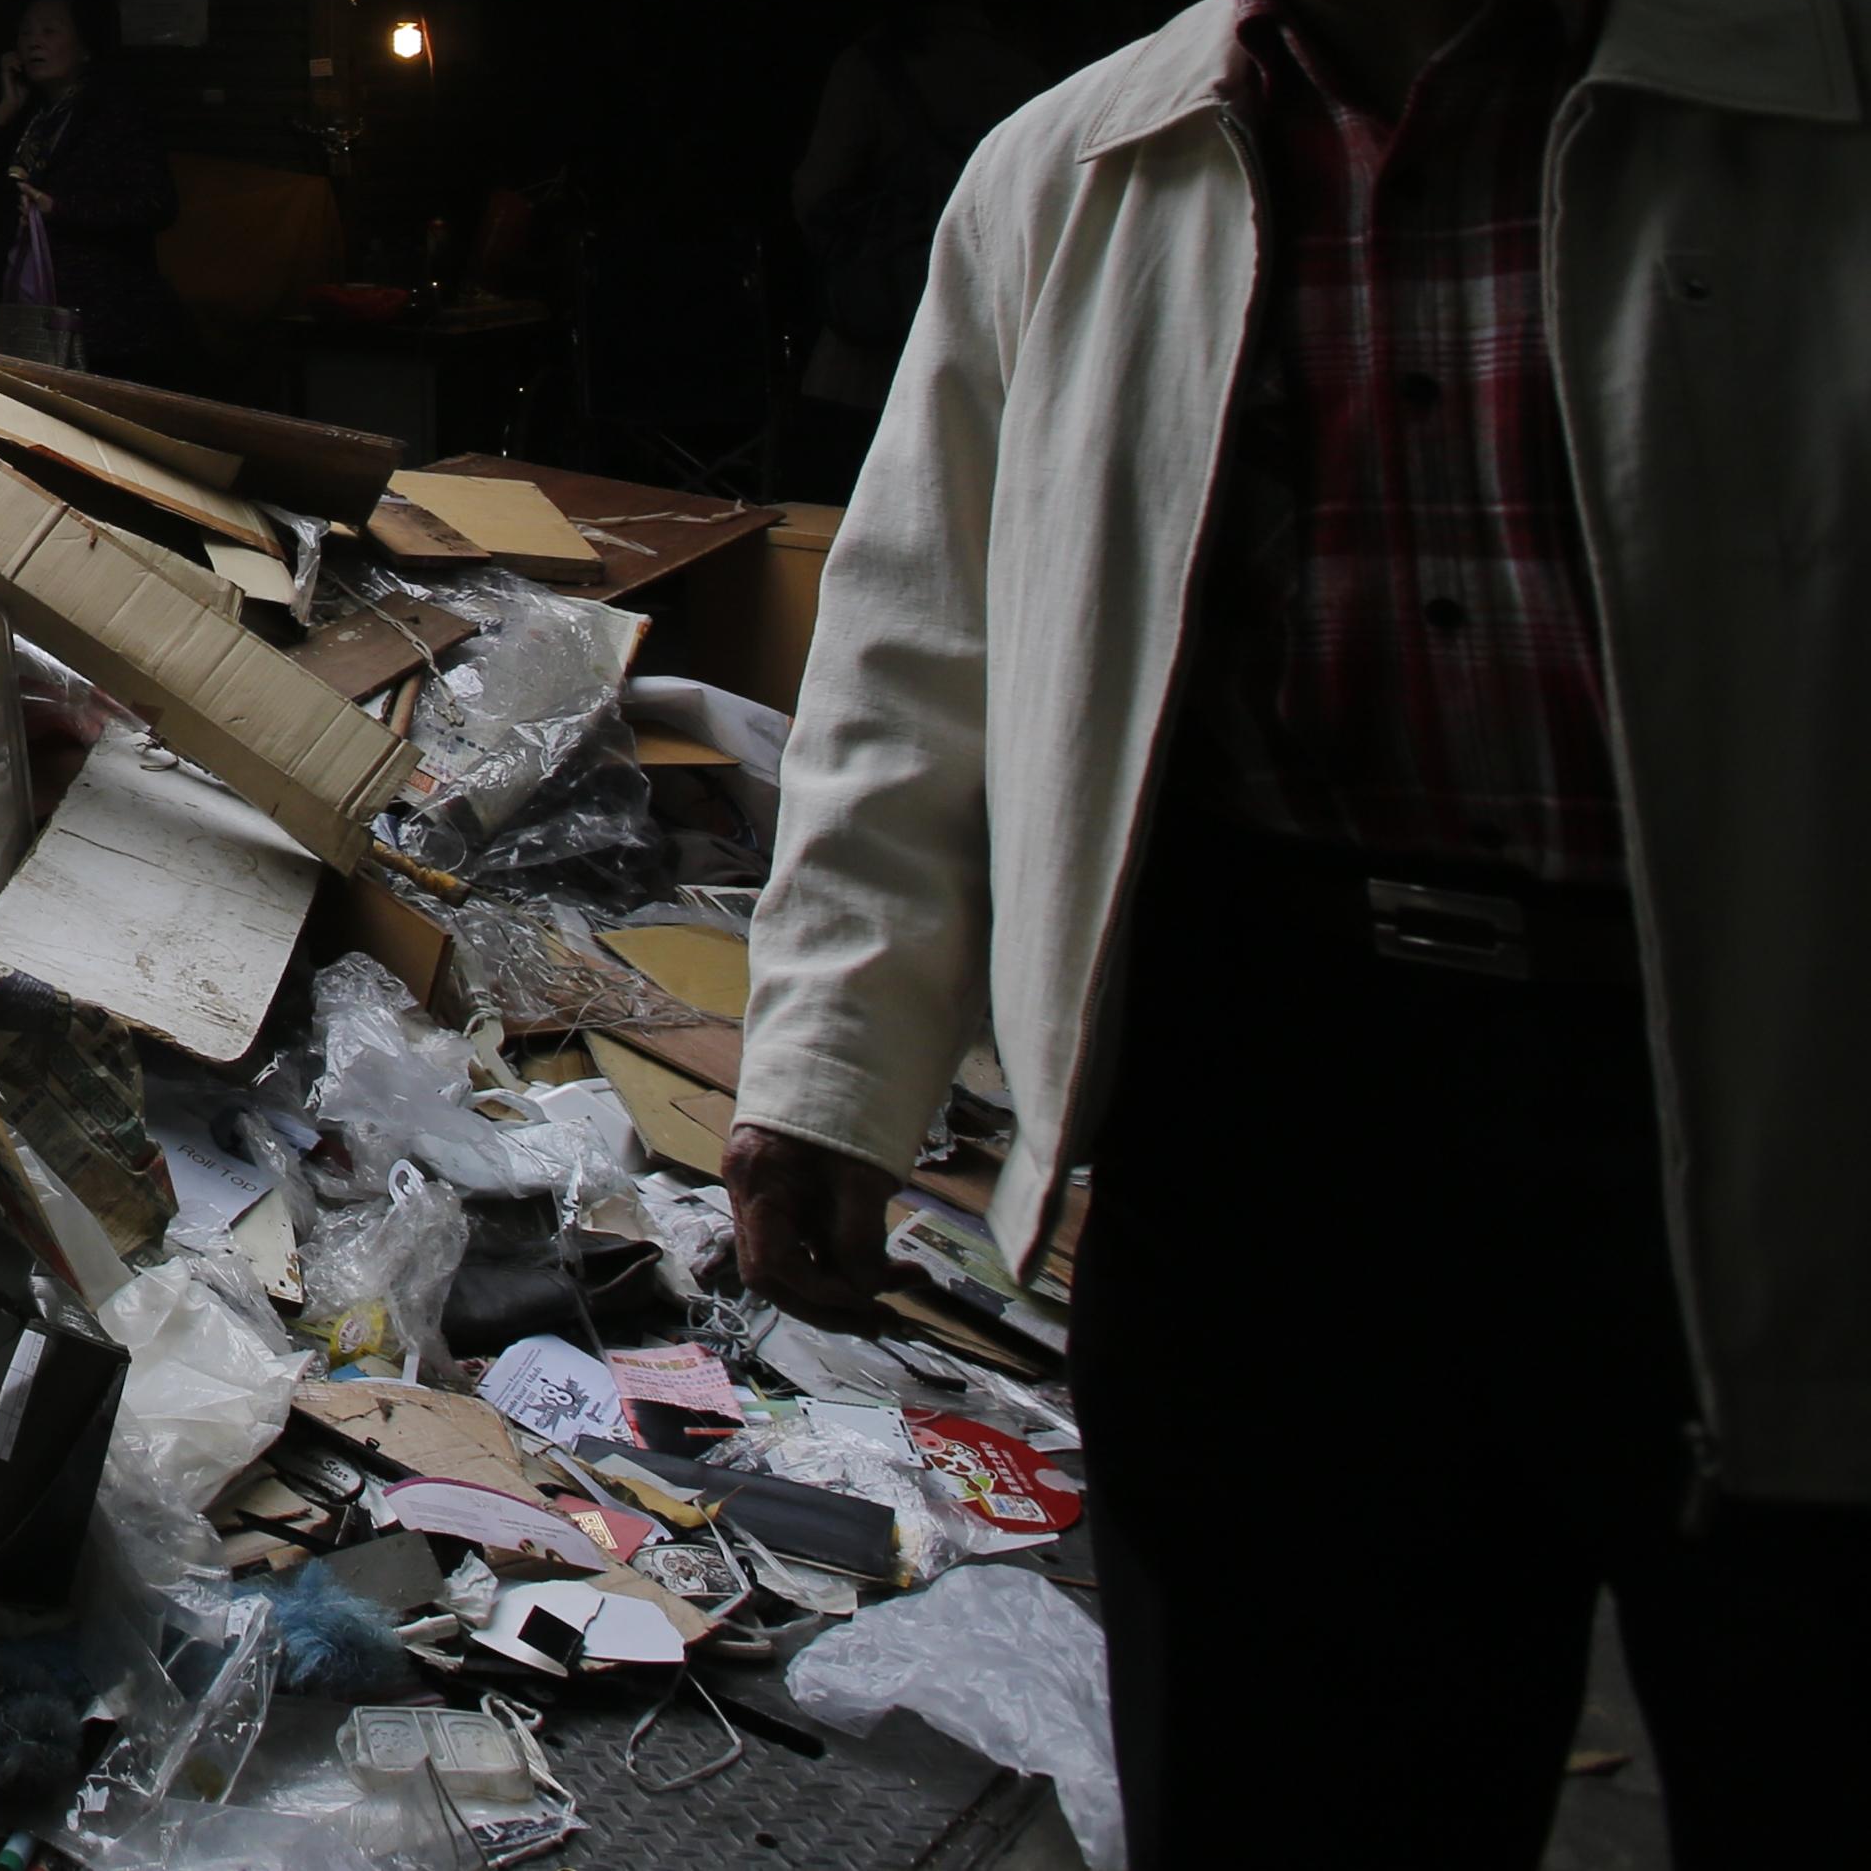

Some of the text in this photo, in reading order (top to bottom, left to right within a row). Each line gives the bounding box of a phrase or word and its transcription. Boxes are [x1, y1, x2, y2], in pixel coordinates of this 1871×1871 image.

[177, 1143, 258, 1194] Roll Top
[321, 1459, 351, 1483] Star
